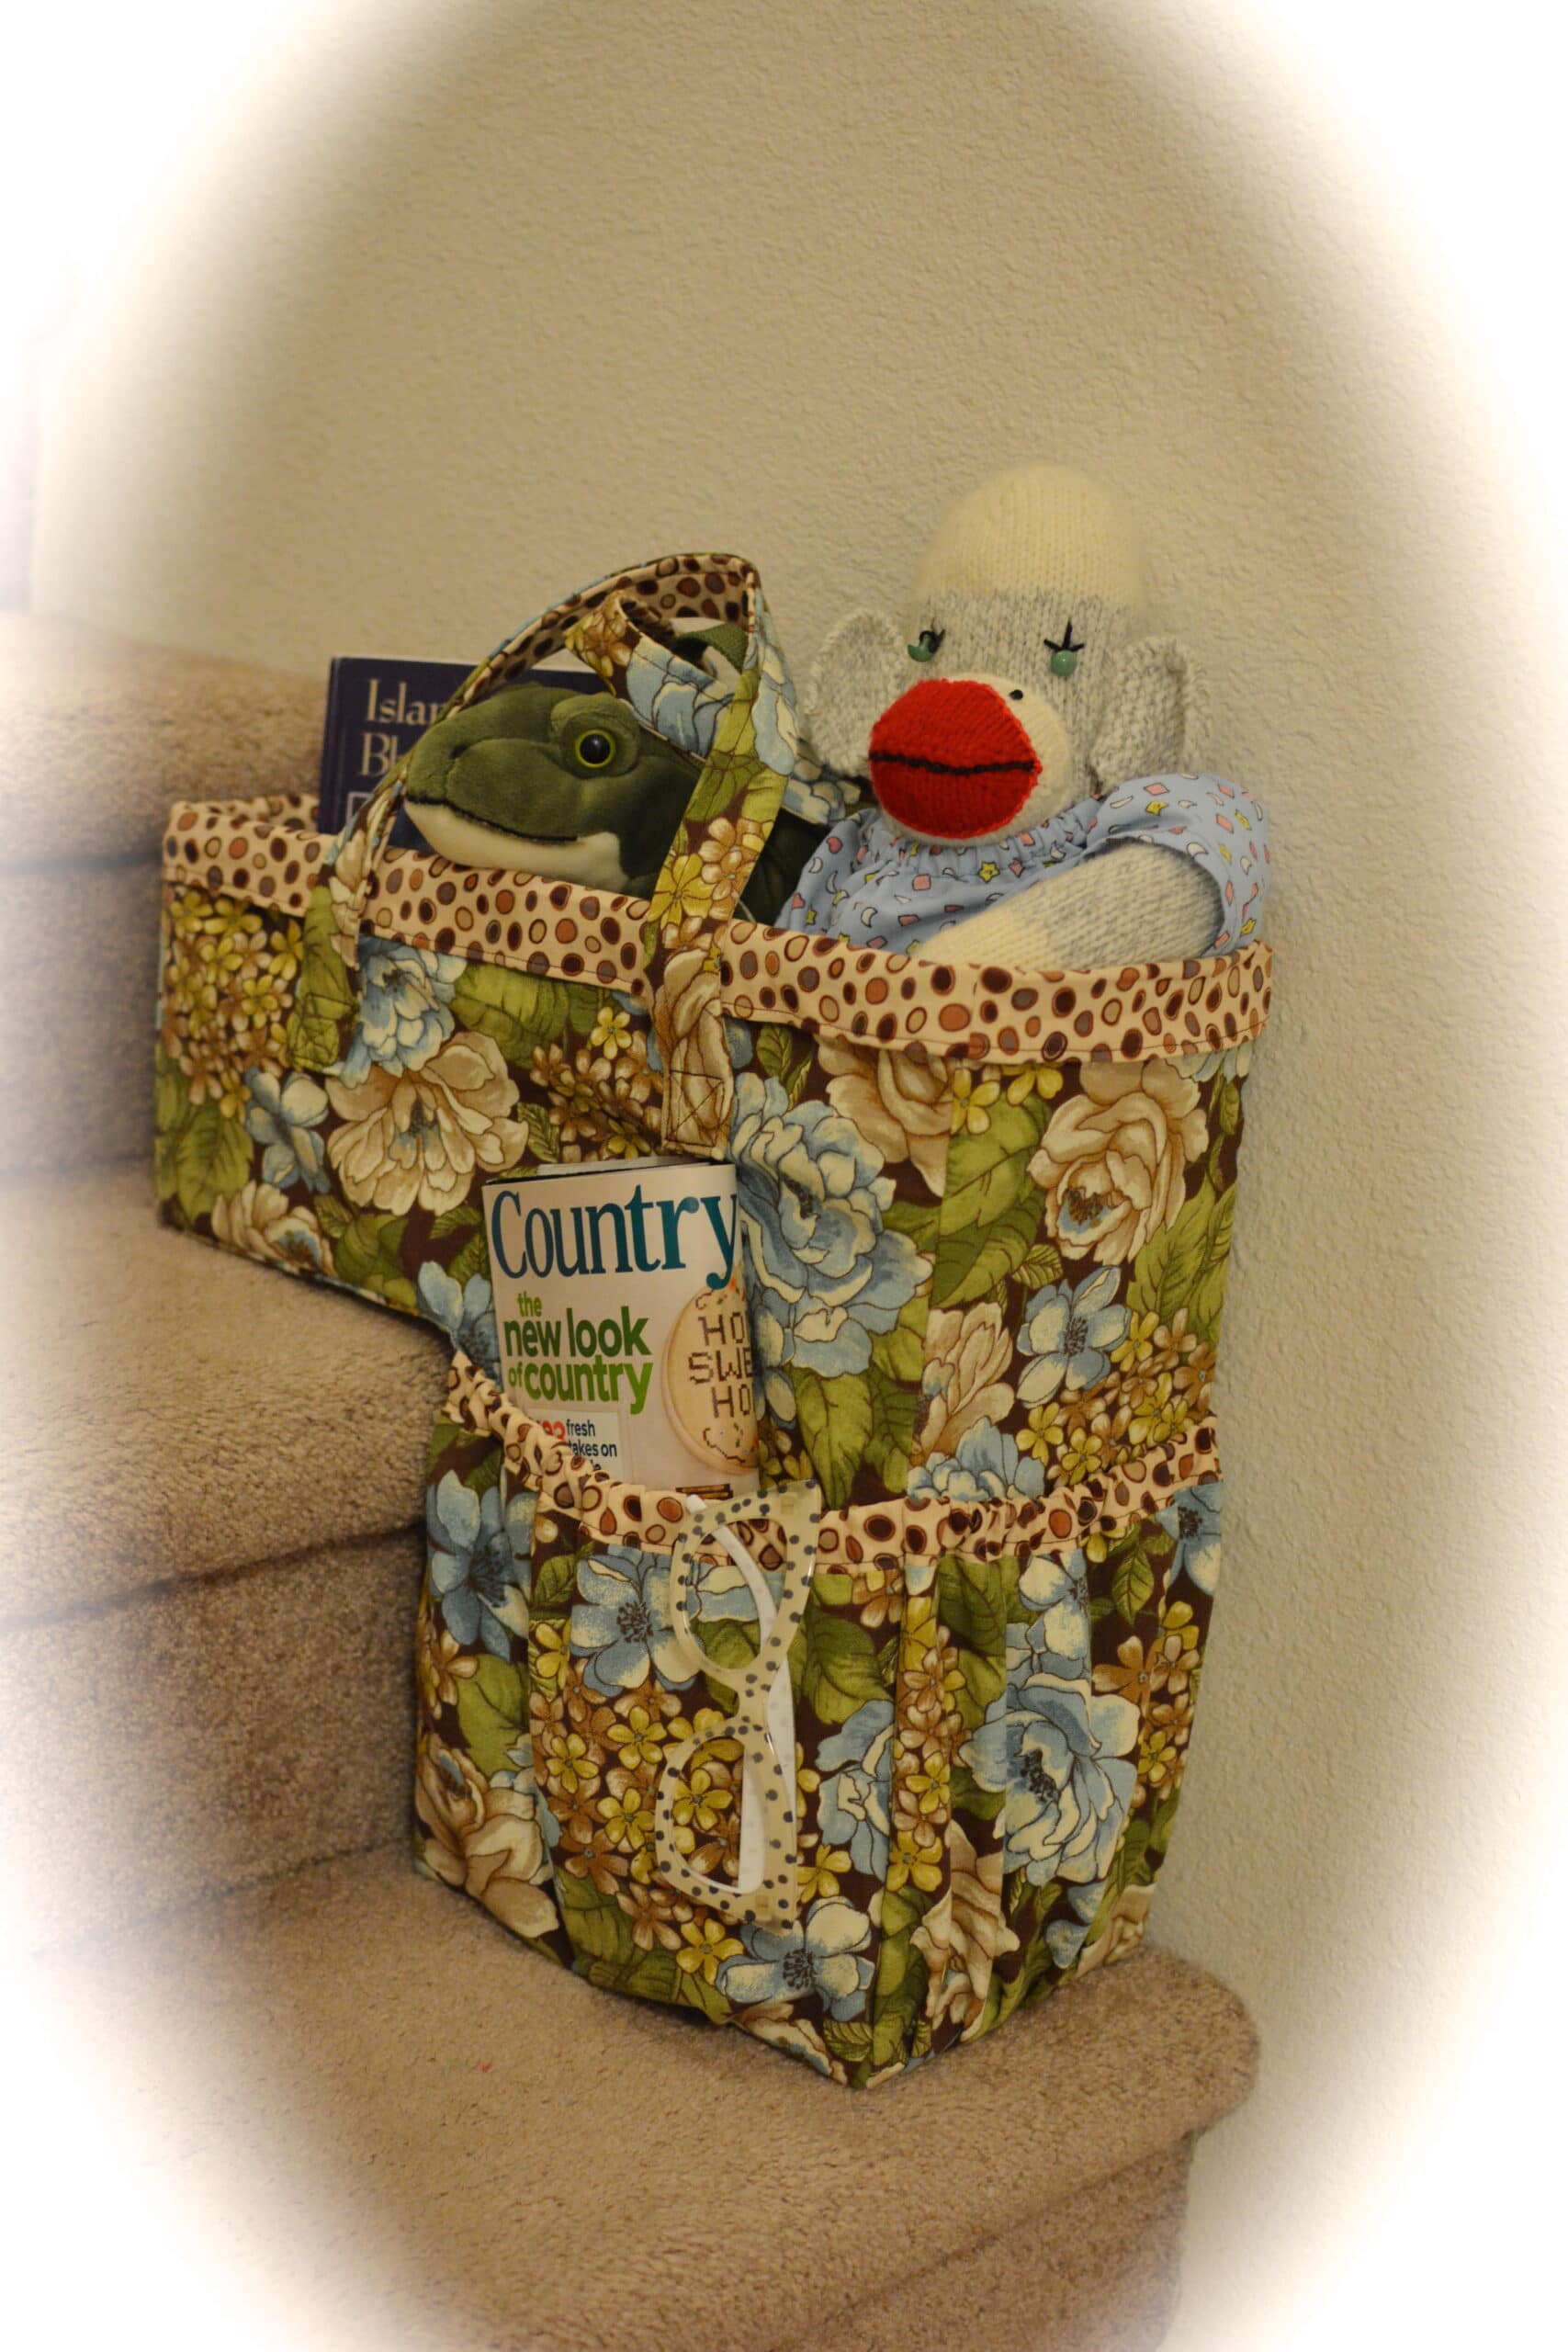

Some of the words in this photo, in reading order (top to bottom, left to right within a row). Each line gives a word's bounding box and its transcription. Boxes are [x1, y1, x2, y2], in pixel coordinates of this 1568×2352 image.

[491, 1184, 737, 1290] Country
[517, 1291, 543, 1317] the
[503, 1319, 561, 1358] new
[566, 1306, 652, 1358] look
[508, 1362, 523, 1388] of
[524, 1354, 654, 1416] country
[566, 1419, 595, 1437] fresh
[601, 1443, 617, 1457] on
